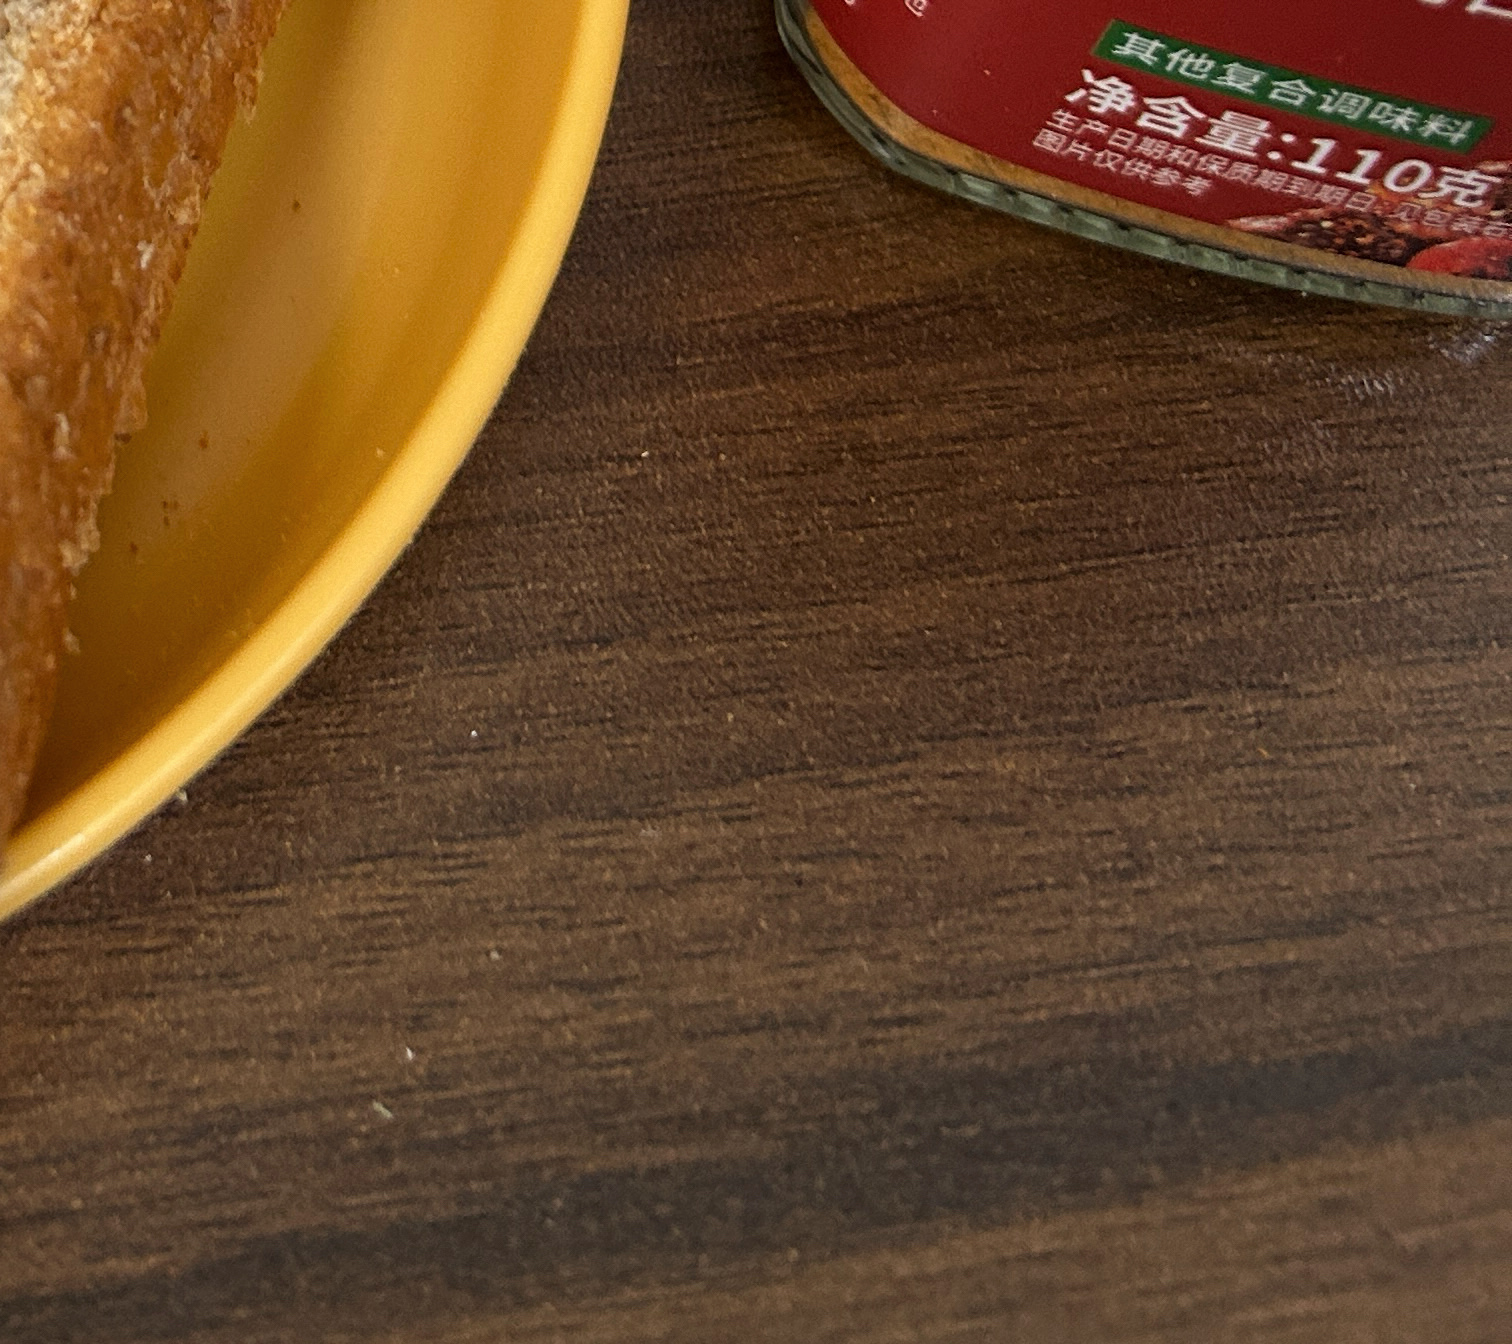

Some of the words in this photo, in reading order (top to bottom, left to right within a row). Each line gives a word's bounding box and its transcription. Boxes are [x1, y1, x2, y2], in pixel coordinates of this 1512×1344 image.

[1110, 30, 1476, 146] 其他复合调味料
[1031, 128, 1215, 198] 图片仅供参考
